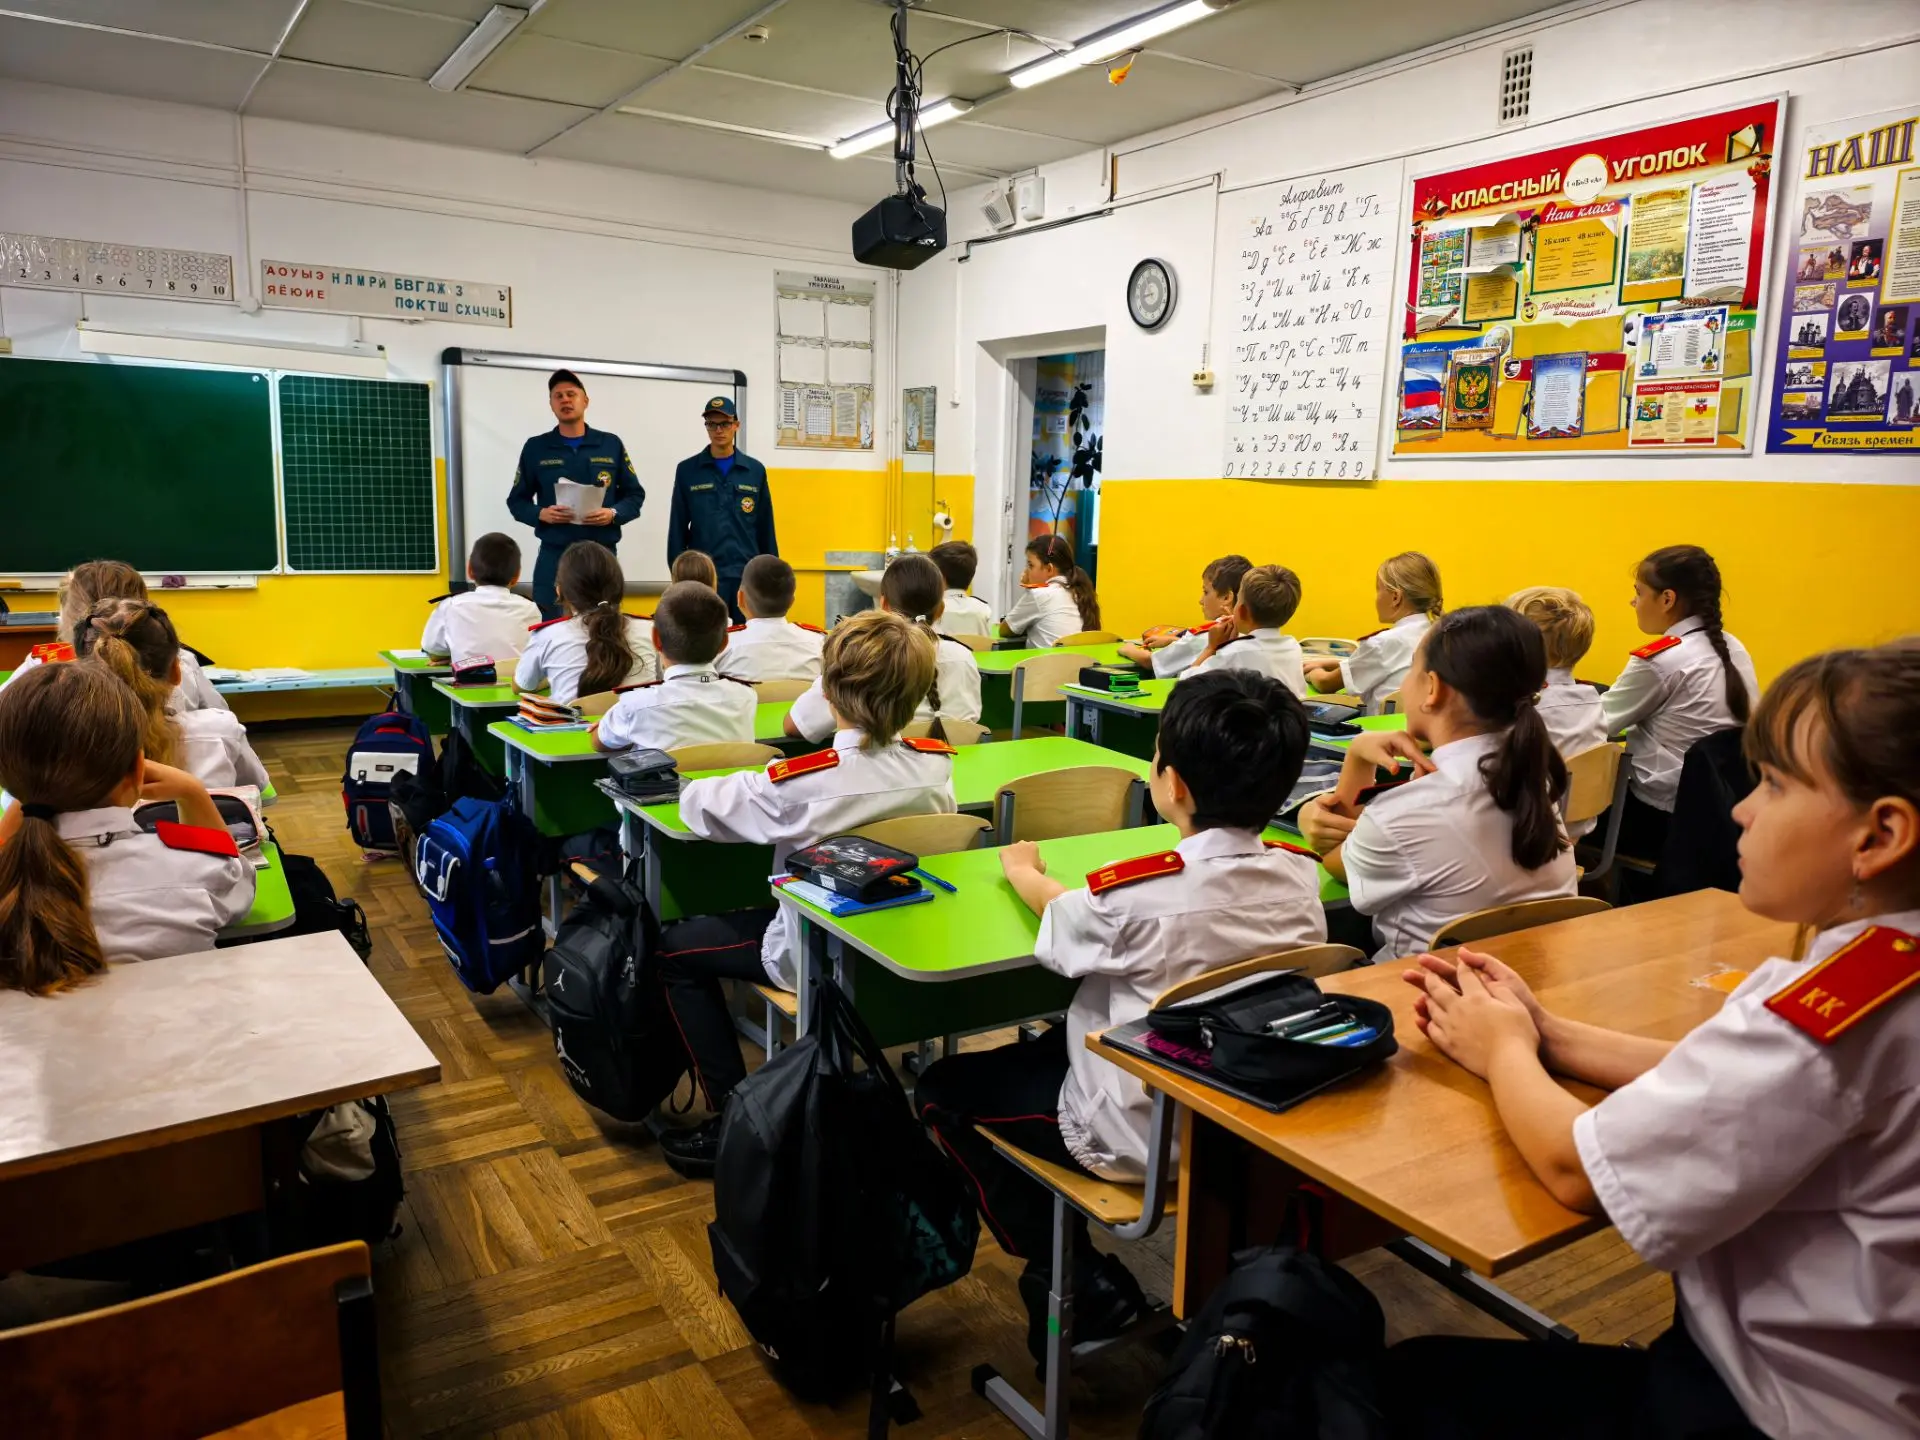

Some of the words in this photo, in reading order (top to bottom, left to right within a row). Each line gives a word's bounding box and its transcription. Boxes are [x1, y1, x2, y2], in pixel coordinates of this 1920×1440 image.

[1450, 168, 1561, 211] КЛАССНЫЙ
[1612, 143, 1708, 180] УГОЛОК
[1280, 179, 1345, 209] Алфавит
[1545, 206, 1574, 223] Наш
[1577, 202, 1615, 217] класс
[20, 269, 27, 278] 2
[44, 271, 51, 280] 3
[73, 273, 80, 282] 4
[96, 275, 103, 284] 5
[119, 278, 126, 286] 6
[146, 280, 153, 289] 7
[169, 281, 175, 290] 8
[191, 283, 197, 292] 9
[213, 285, 225, 295] 10
[1823, 435, 1861, 445] Связь
[1865, 436, 1914, 448] времен
[1225, 462, 1234, 476] 0
[1239, 462, 1245, 475] 1
[1250, 461, 1259, 476] 2
[1264, 461, 1272, 476] 3
[1278, 462, 1286, 475] 4
[1292, 461, 1302, 477] 5
[1307, 461, 1316, 476] 6
[1323, 460, 1333, 475] 7
[1338, 461, 1347, 476] 8
[1354, 461, 1363, 477] 9
